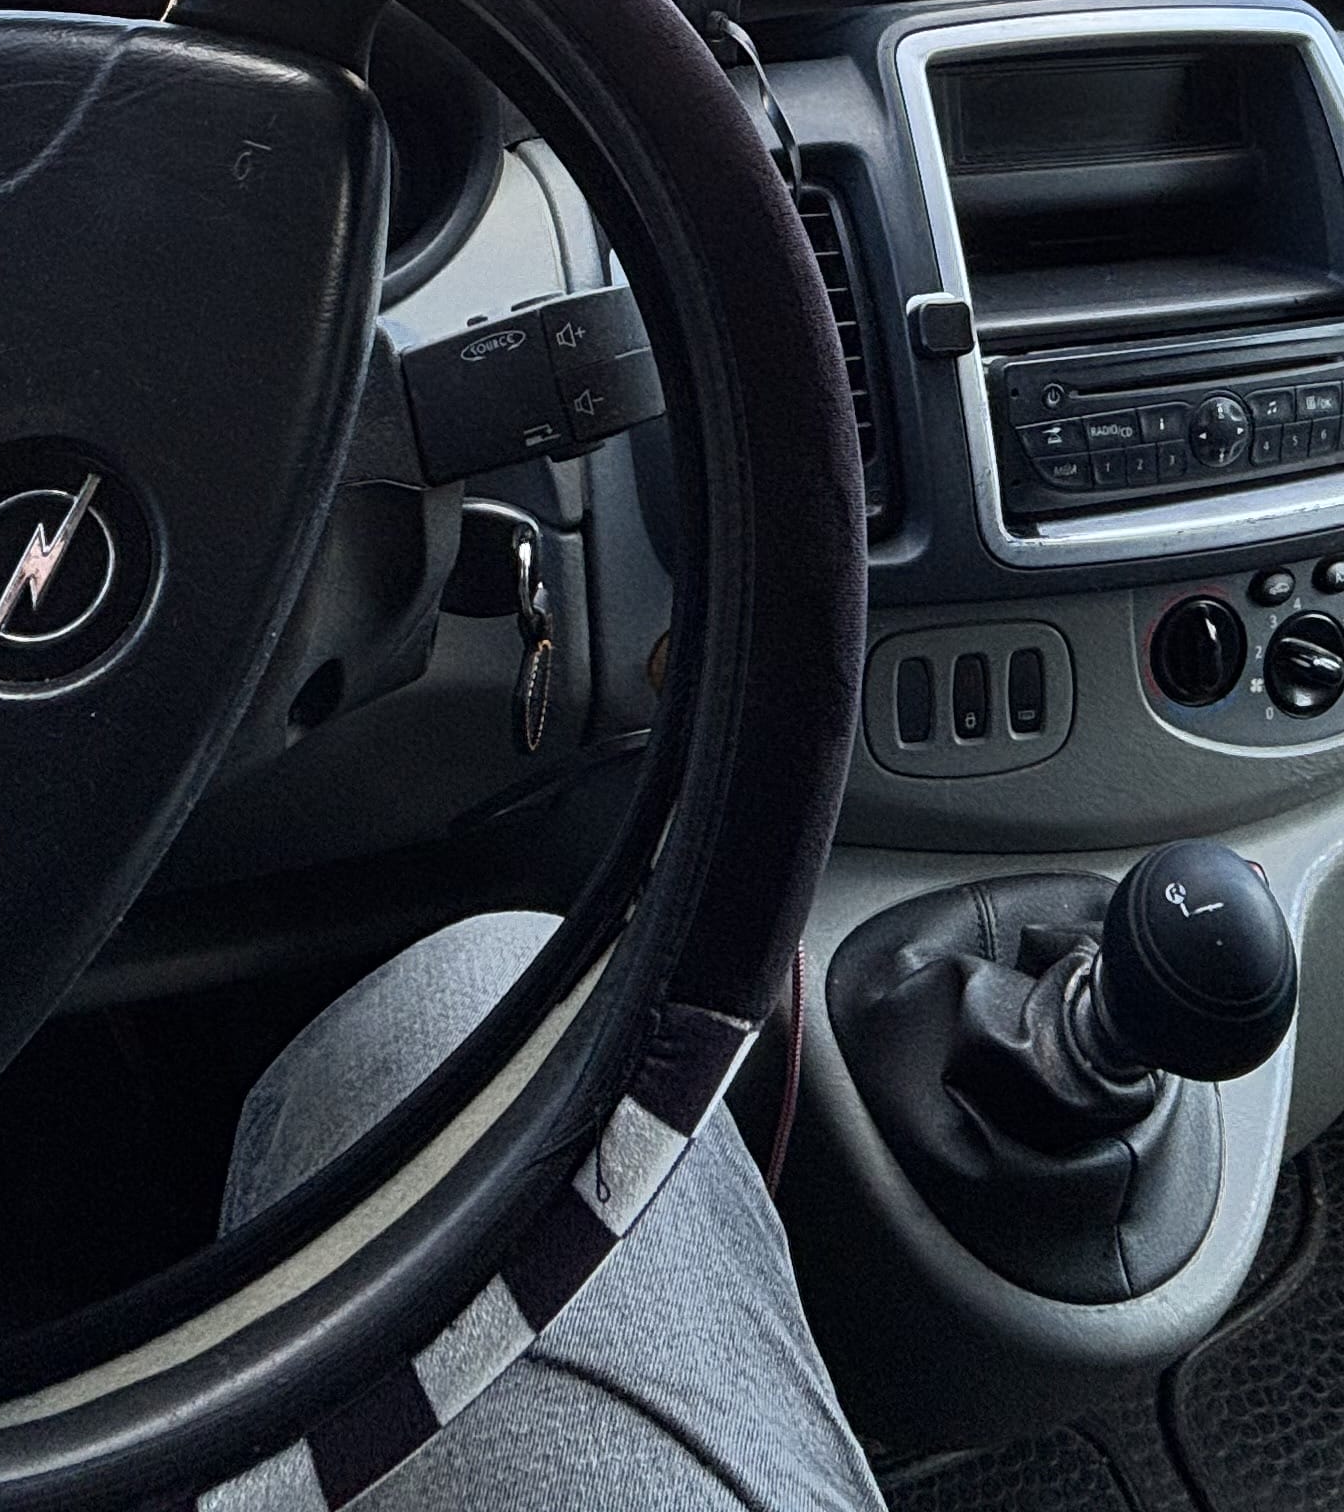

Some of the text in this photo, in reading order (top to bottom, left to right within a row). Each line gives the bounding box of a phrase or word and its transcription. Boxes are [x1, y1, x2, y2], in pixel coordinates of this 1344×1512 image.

[1320, 428, 1327, 441] 6
[1293, 597, 1301, 610] 4
[1270, 615, 1278, 629] 3
[1255, 645, 1262, 659] 2
[1169, 884, 1186, 901] R
